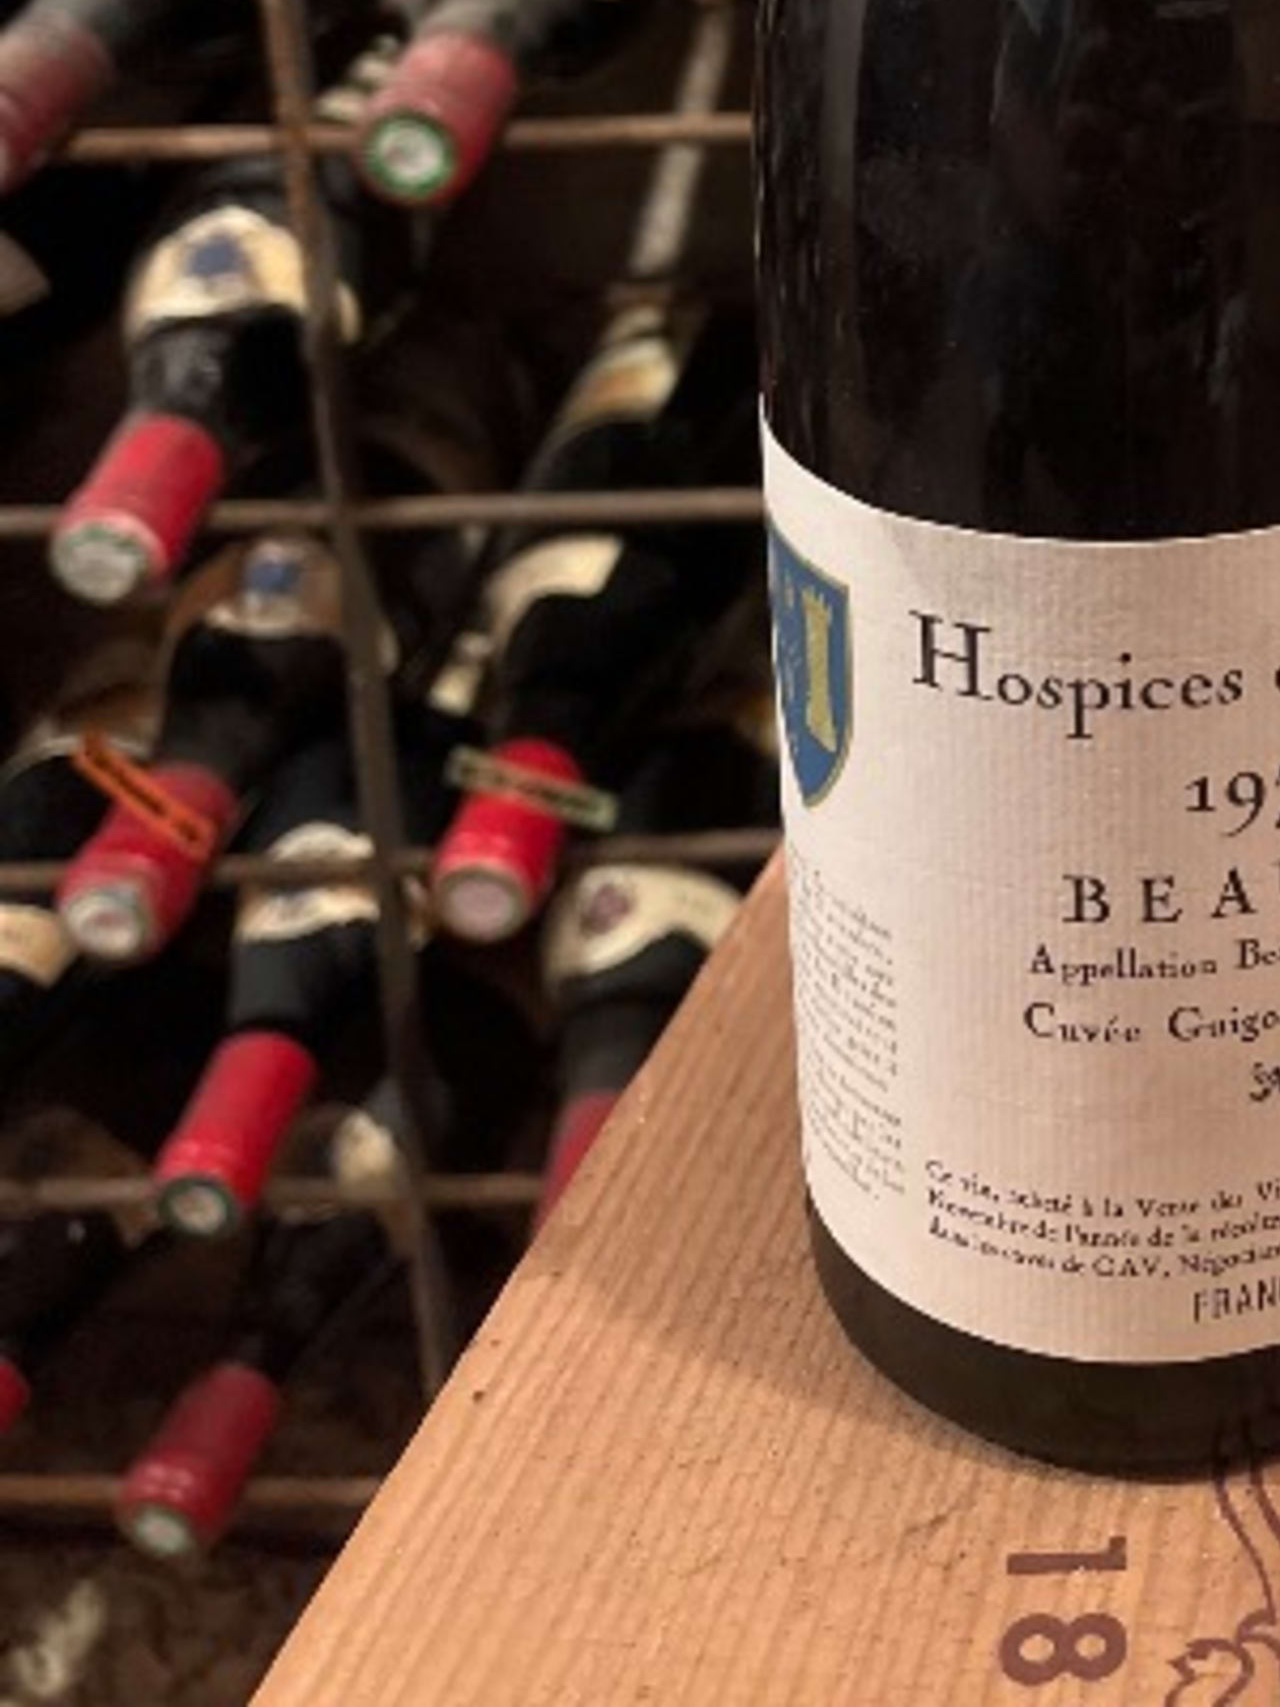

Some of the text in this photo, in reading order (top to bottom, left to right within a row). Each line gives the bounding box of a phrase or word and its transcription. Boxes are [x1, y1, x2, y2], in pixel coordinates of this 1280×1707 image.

[907, 607, 1245, 740] Hospices
[1029, 942, 1218, 987] Appellation
[1023, 1000, 1142, 1044] Cuvée
[1104, 1197, 1124, 1218] la
[1000, 1534, 1128, 1687] 18
